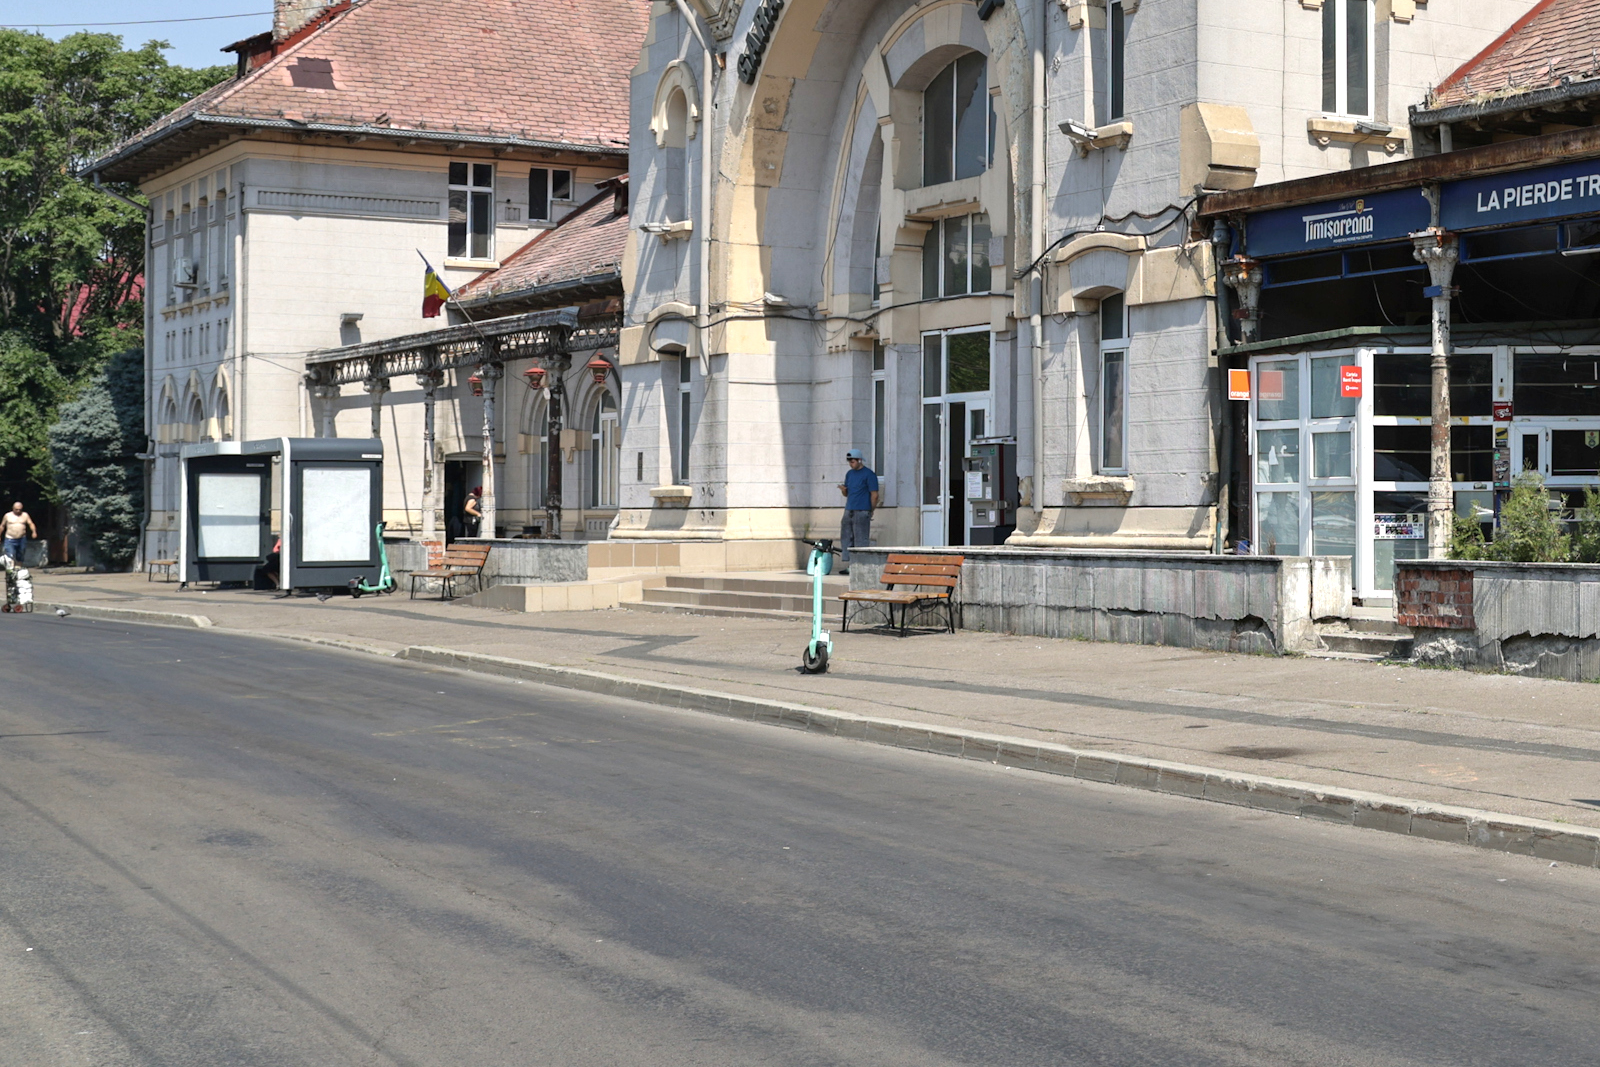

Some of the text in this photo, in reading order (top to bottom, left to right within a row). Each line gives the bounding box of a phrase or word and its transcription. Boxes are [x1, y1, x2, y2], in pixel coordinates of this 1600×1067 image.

[1476, 189, 1501, 213] LA
[1503, 177, 1573, 210] PIERDE
[1230, 390, 1250, 399] orange
